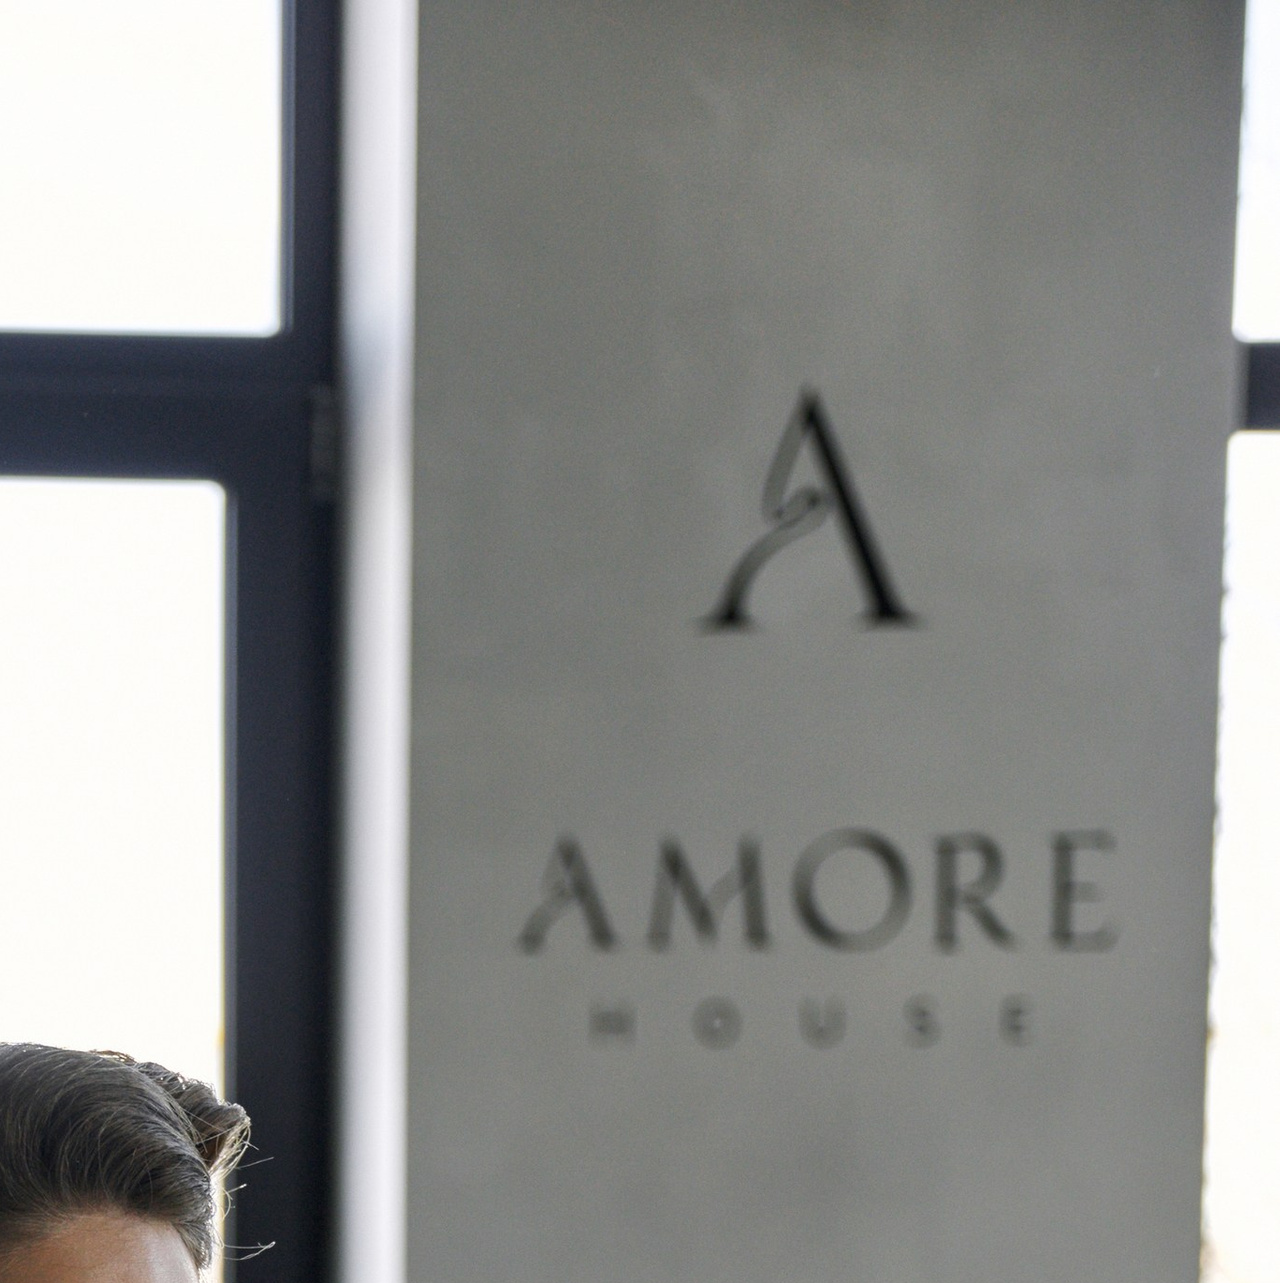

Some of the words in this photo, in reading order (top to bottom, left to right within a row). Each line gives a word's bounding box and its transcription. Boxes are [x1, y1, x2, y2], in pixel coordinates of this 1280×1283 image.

[696, 384, 923, 636] A
[516, 826, 1119, 956] AMORE
[586, 993, 1037, 1051] HOUSE
